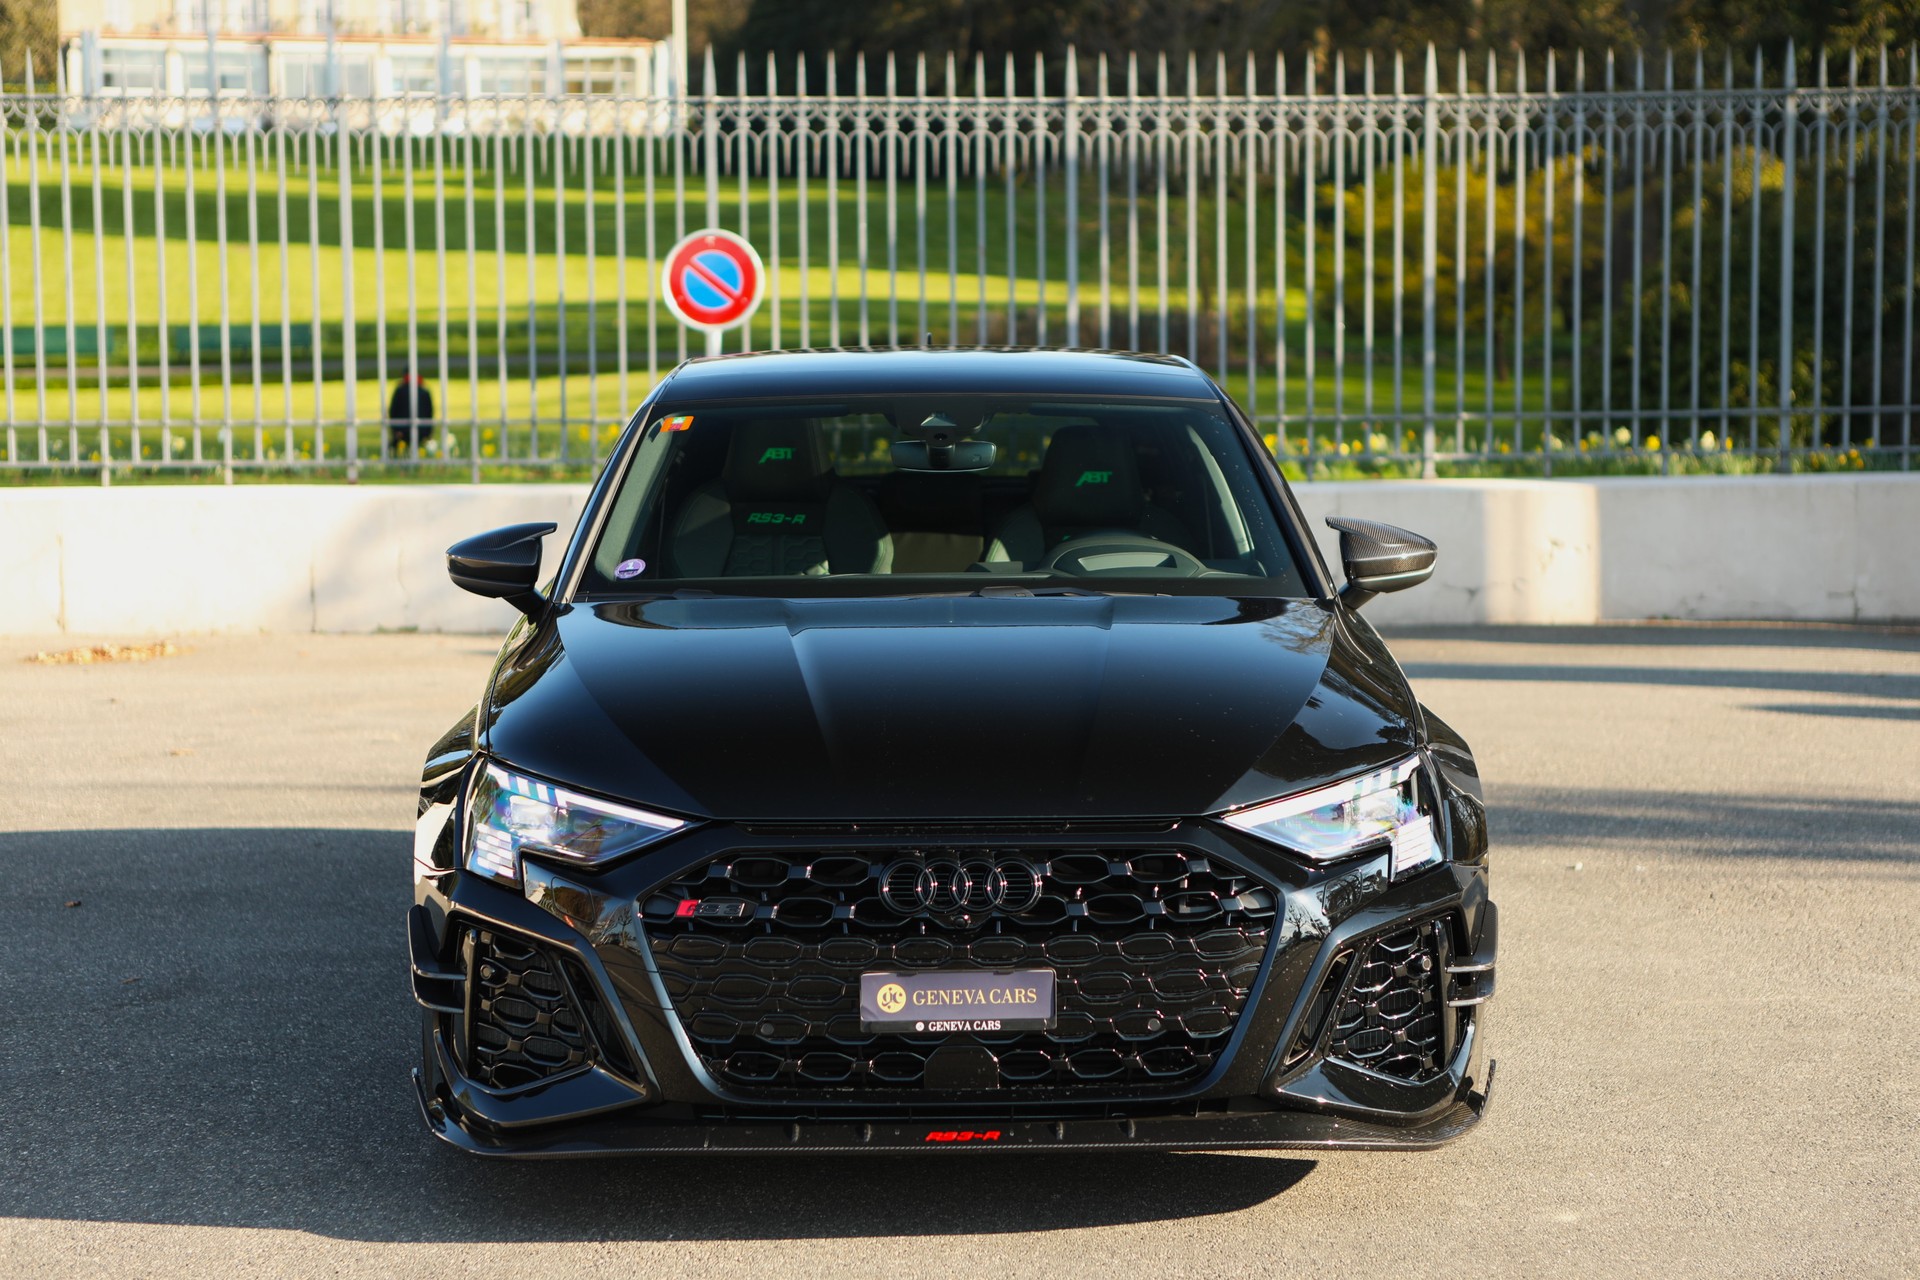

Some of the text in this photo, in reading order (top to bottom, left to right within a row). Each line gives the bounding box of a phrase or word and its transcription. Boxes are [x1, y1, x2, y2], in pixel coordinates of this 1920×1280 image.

[758, 447, 796, 464] ABT
[1074, 470, 1112, 487] ABT
[747, 512, 806, 524] RS3-R
[912, 988, 1037, 1006] GENEVA CARS
[928, 1020, 1001, 1032] GENEVA CARS
[925, 1131, 1001, 1142] RS3-R
